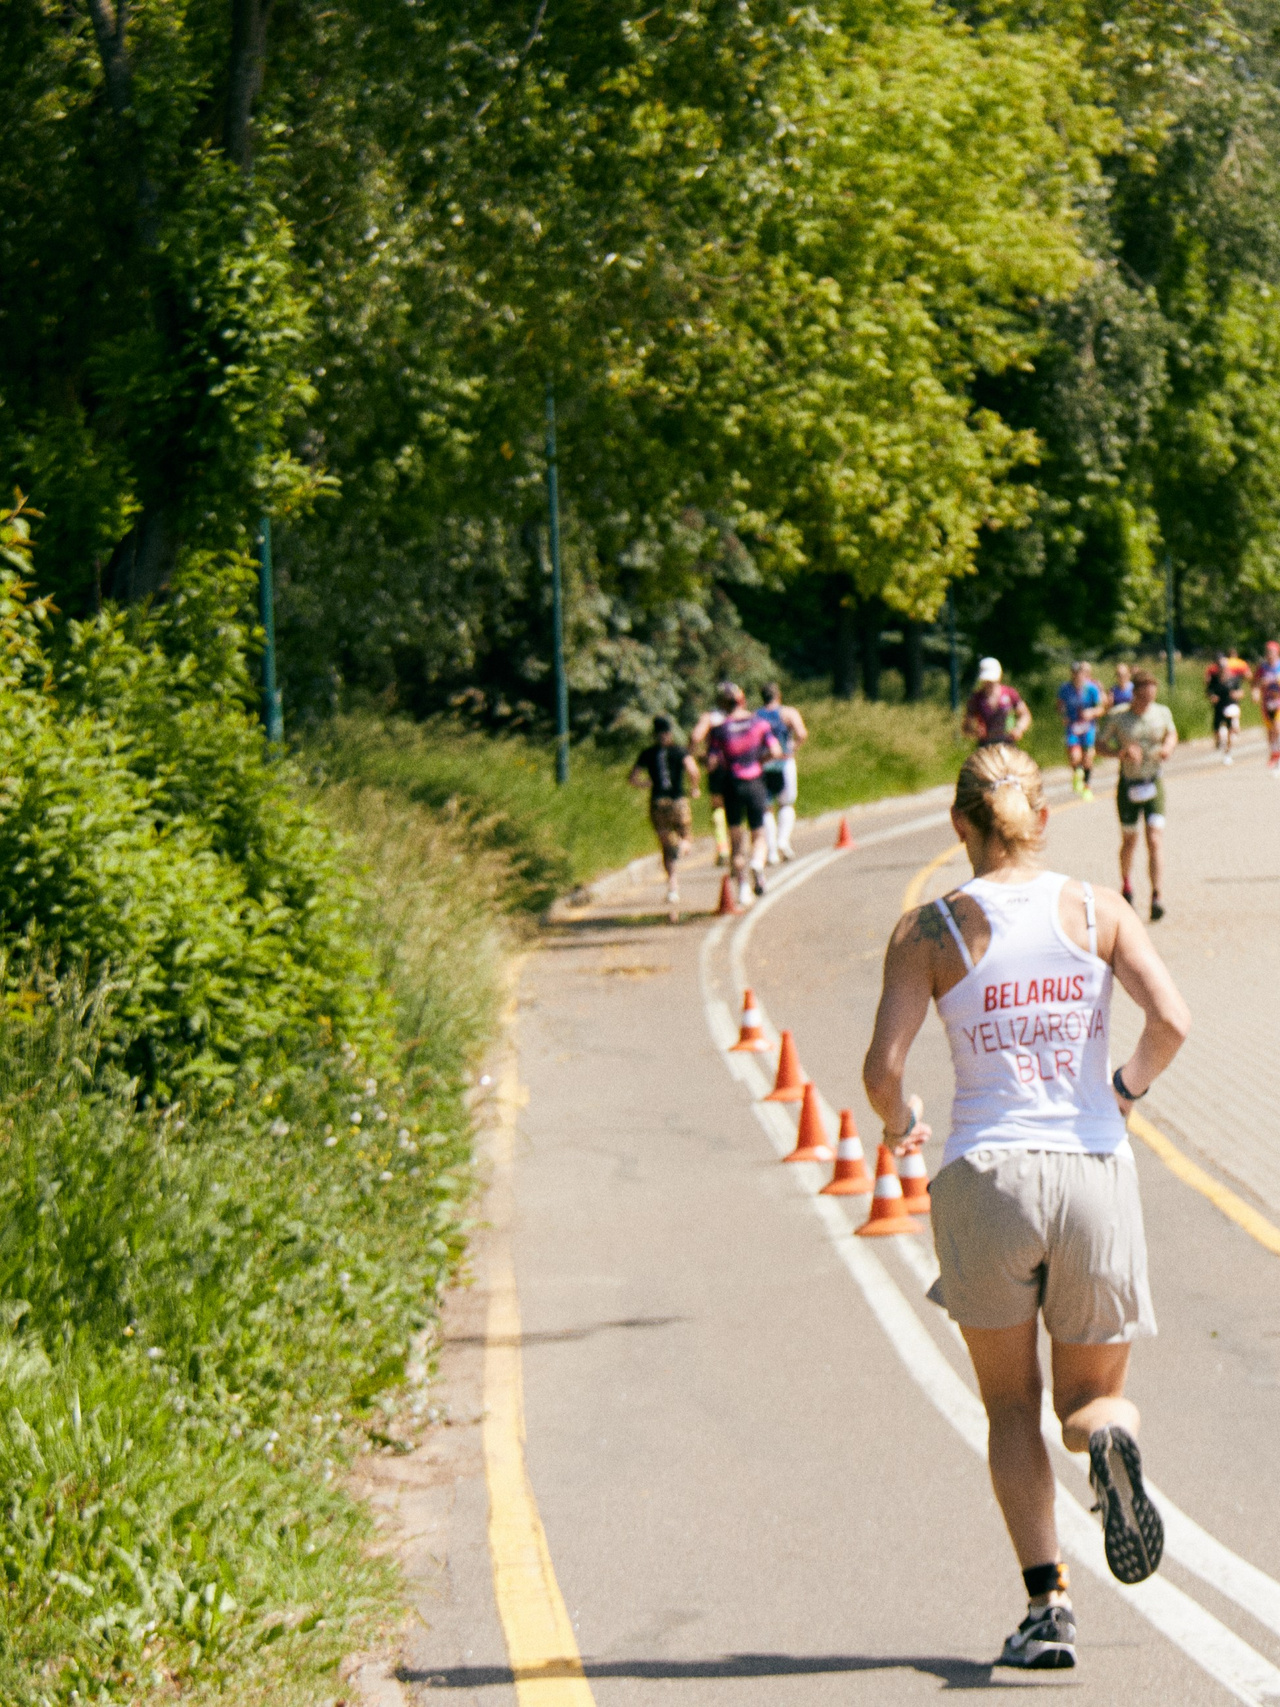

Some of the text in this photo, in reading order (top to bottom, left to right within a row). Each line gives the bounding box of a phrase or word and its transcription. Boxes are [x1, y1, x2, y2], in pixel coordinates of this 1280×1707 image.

[984, 976, 1084, 1012] BELARUS
[964, 1008, 1105, 1054] YELIZAROVA
[1016, 1049, 1076, 1083] BLR
